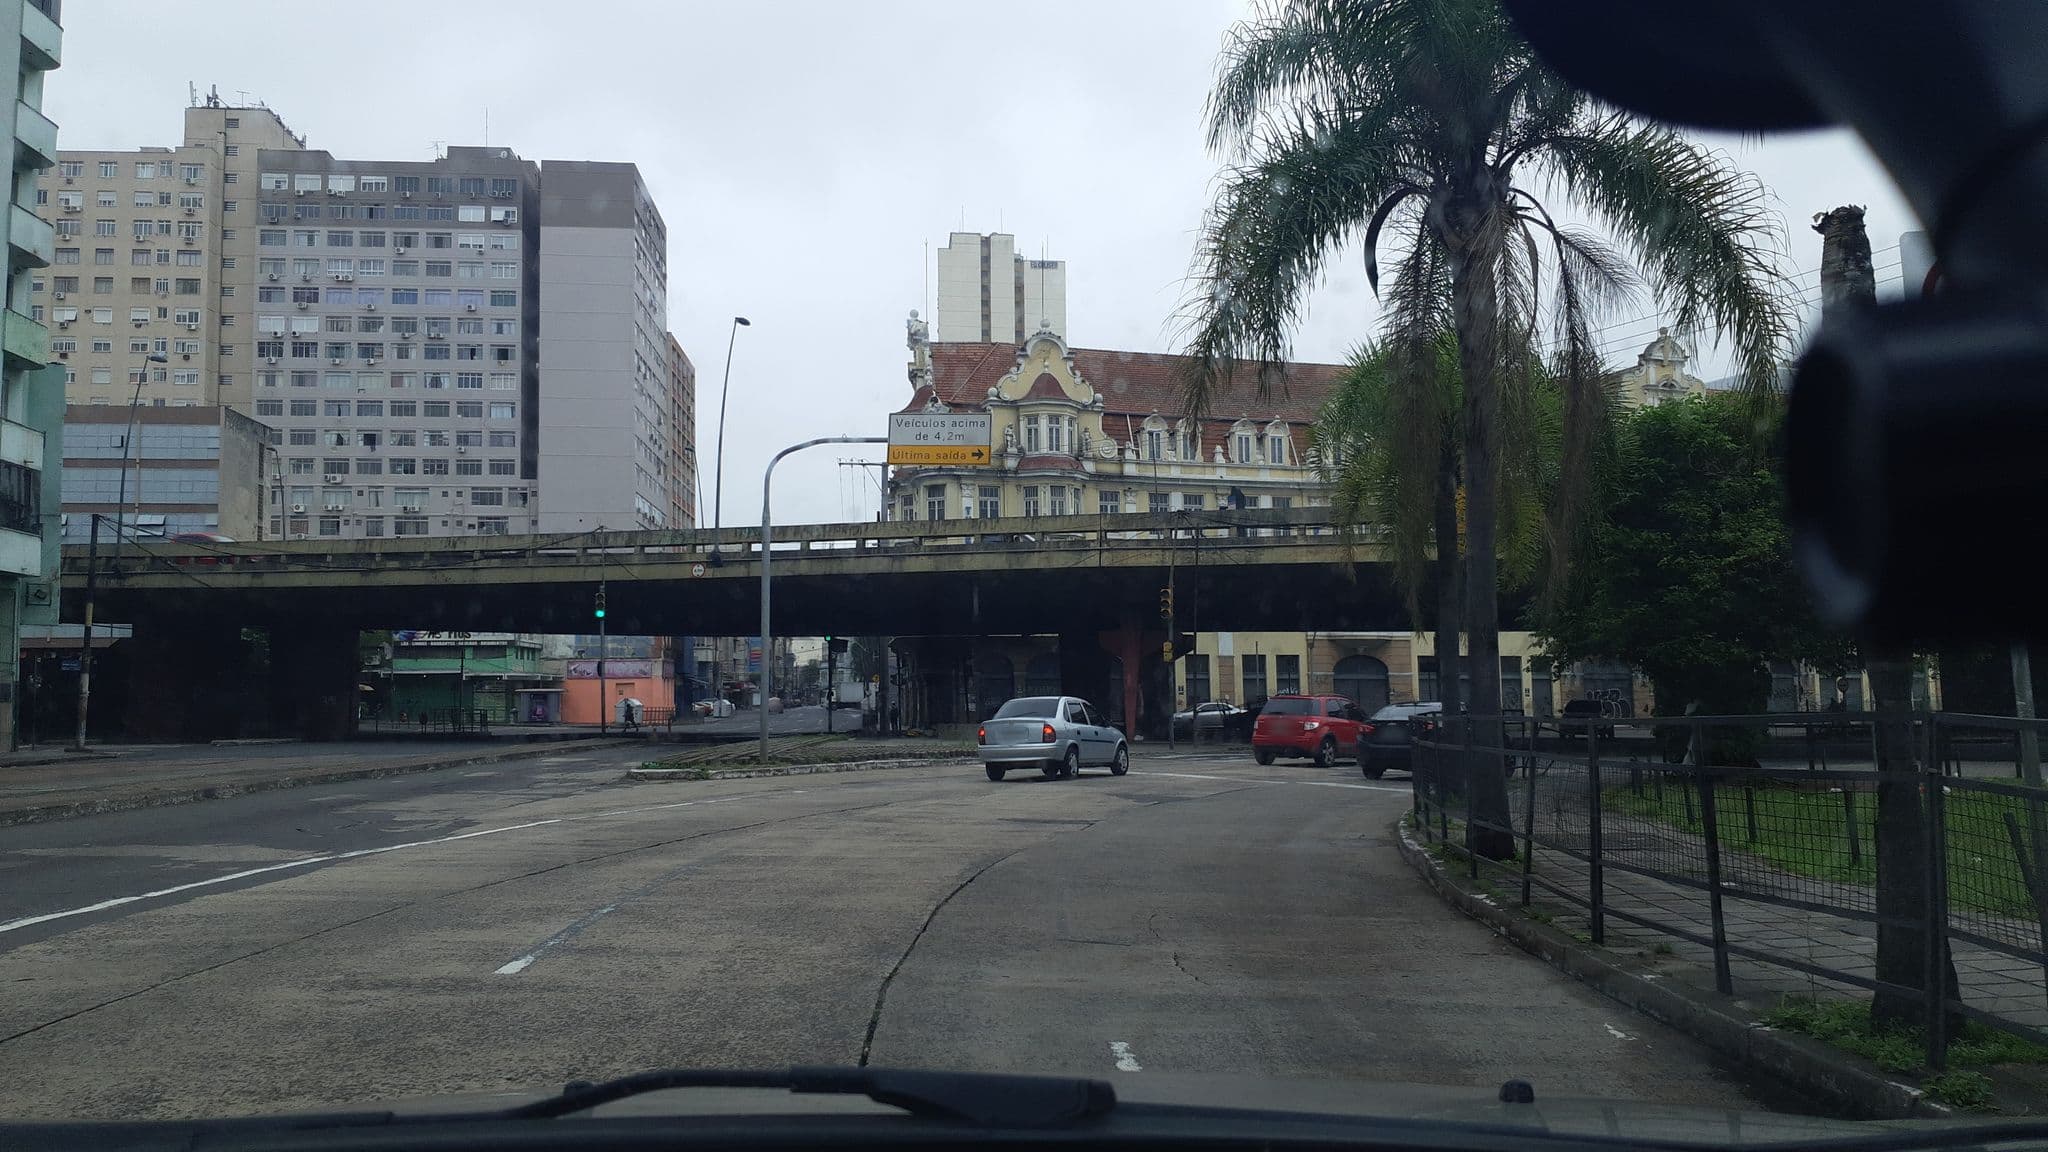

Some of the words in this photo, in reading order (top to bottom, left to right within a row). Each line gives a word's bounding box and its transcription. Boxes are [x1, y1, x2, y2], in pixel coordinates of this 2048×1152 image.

[896, 418, 946, 428] Veículos
[951, 418, 986, 428] acima
[915, 431, 929, 441] de
[934, 431, 965, 442] 4,2m
[936, 450, 967, 460] saída
